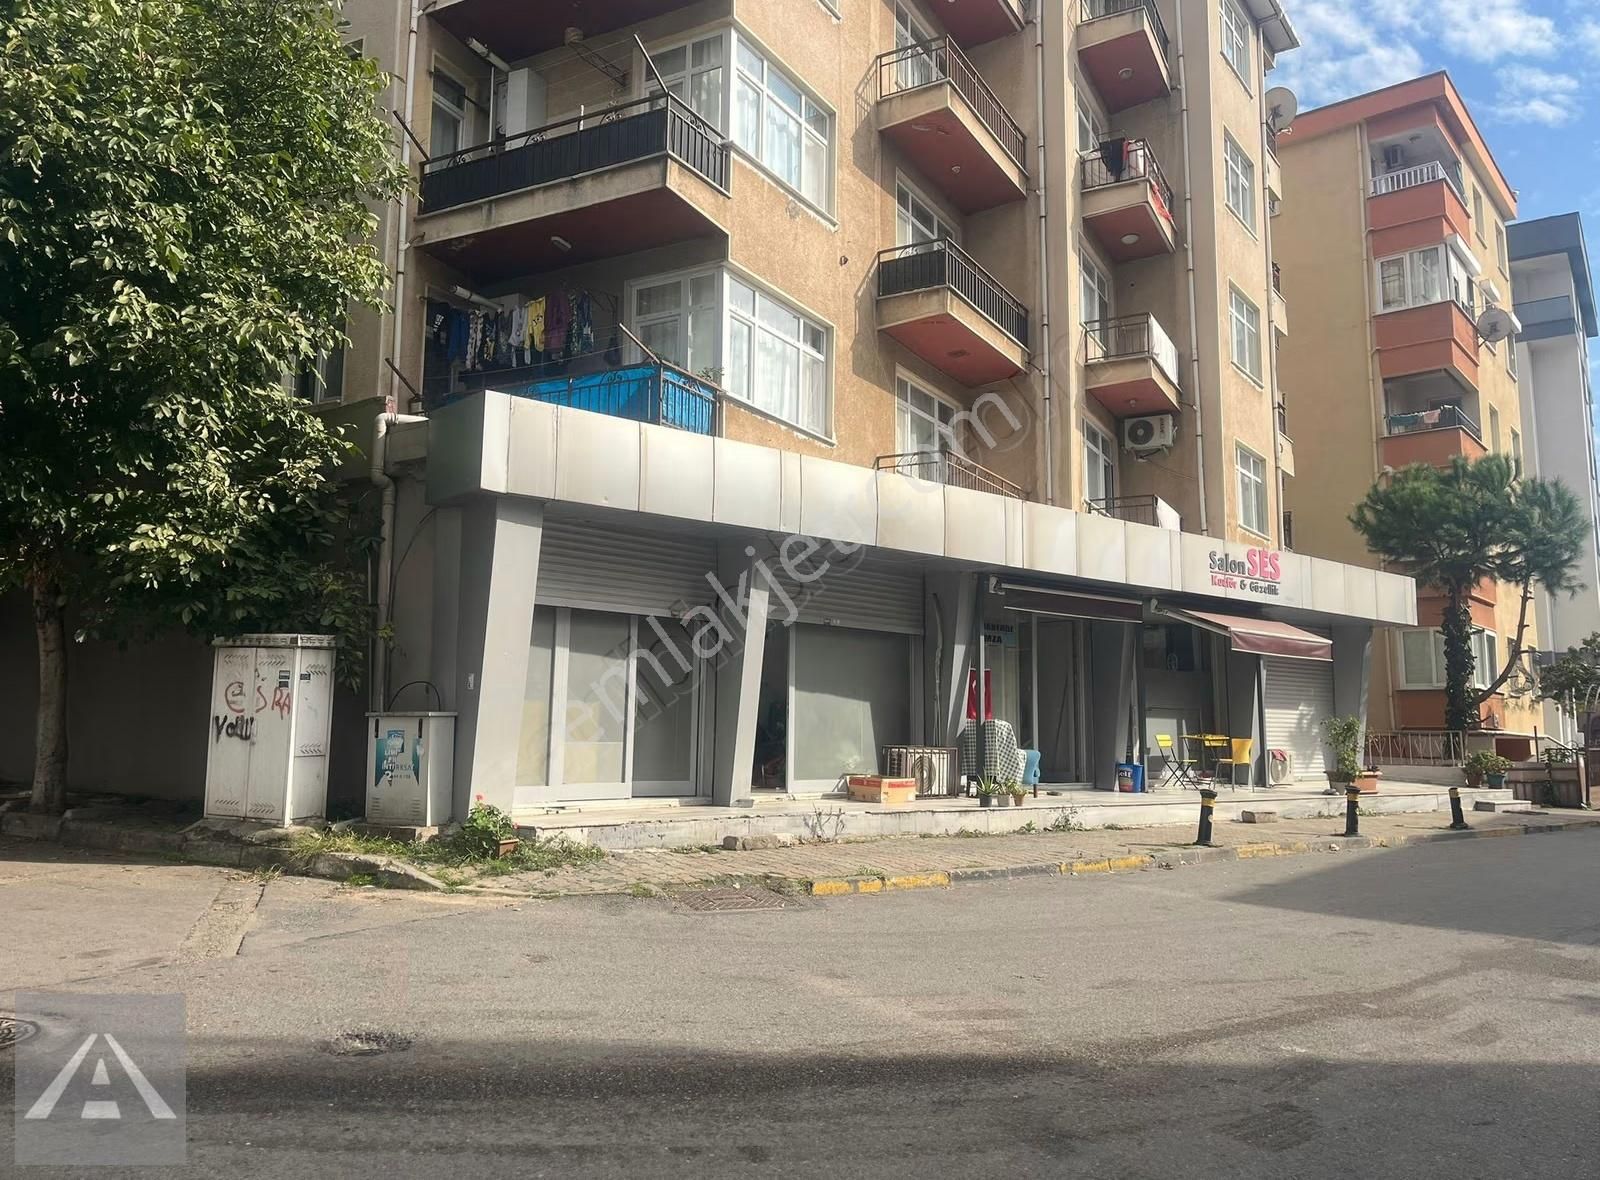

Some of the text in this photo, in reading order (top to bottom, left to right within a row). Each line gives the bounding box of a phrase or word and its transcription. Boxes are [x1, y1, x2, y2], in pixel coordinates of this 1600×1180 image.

[1209, 548, 1280, 580] Salon SES
[1249, 581, 1279, 595] Güzellik
